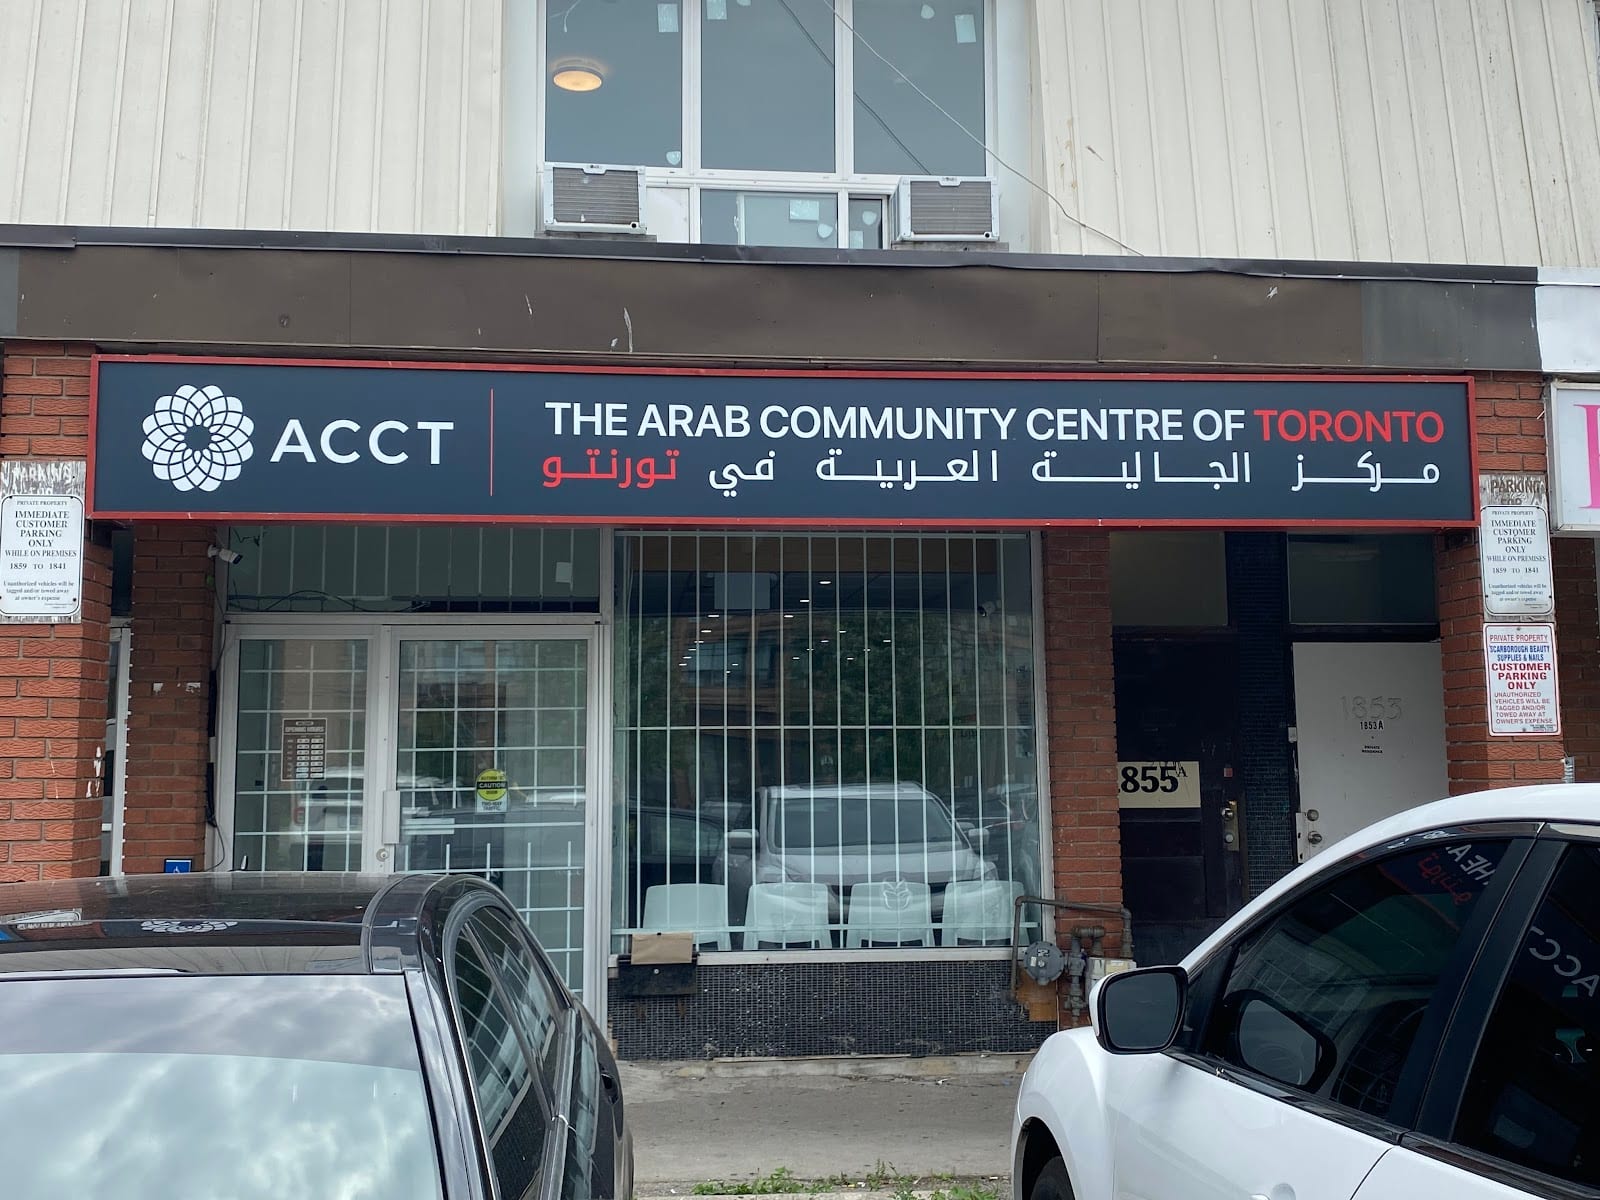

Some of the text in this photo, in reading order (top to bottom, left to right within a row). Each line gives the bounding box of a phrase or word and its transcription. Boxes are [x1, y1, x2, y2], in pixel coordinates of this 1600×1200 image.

[545, 402, 1444, 443] THE ARAB COMMUNITY CENTRE OF TORONTO
[270, 419, 453, 464] ACCT
[542, 448, 1440, 497] مركز الجالية العربية في تورنتو
[15, 510, 70, 519] IMMEDIATE
[16, 520, 68, 528] CUSTOMER
[1491, 519, 1537, 527] IMMEDIATE
[20, 529, 62, 537] PARKING
[1493, 528, 1536, 536] CUSTOMER
[28, 539, 53, 547] ONLY
[5, 549, 29, 557] WHILE
[42, 549, 77, 558] PREMISES
[10, 562, 27, 570] 1859
[49, 562, 67, 570] 1841
[1489, 645, 1550, 653] SCARBOROUGH BEAUTY
[1497, 654, 1522, 662] SUPPLIES
[1491, 662, 1552, 671] CUSTOMER
[1498, 672, 1547, 681] PARKING
[1507, 681, 1537, 690] ONLY
[1341, 696, 1402, 720] 1853
